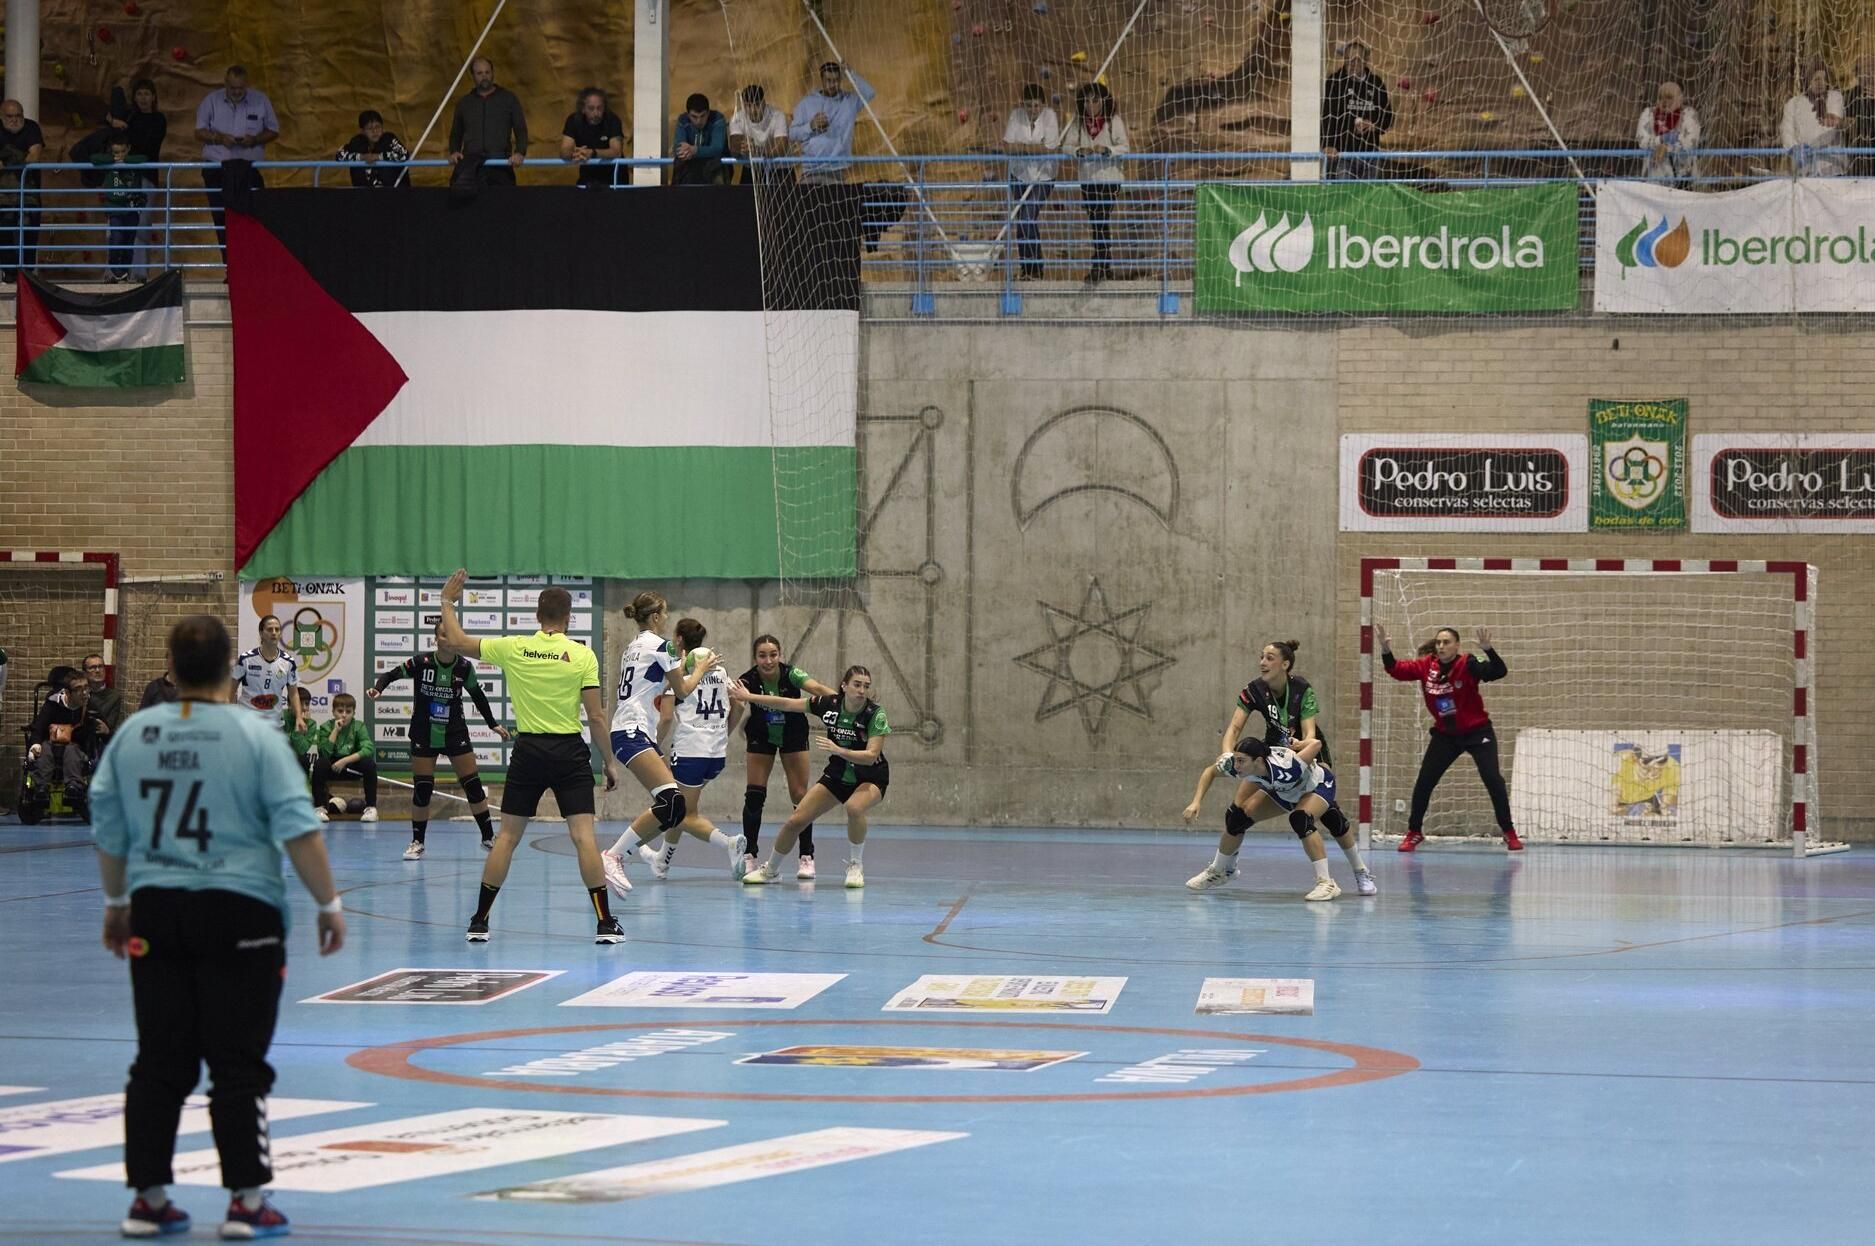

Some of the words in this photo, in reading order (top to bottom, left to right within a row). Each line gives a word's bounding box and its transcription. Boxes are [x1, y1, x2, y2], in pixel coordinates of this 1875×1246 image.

[1327, 225, 1545, 270] Iberdrola
[1702, 225, 1875, 266] Iberdrol
[1374, 457, 1468, 492] Pedro
[1483, 458, 1553, 492] Luis
[1727, 458, 1823, 492] Pedro
[1394, 496, 1469, 508] conservas
[1472, 495, 1532, 508] selectas
[1747, 498, 1824, 509] conservas
[1828, 496, 1875, 509] select
[523, 648, 560, 660] helvetia
[264, 678, 271, 690] 8
[422, 668, 434, 683] 10
[695, 687, 726, 721] 44
[1267, 704, 1279, 720] 19
[822, 710, 839, 726] 23
[158, 750, 200, 770] MERA
[140, 779, 213, 853] 74
